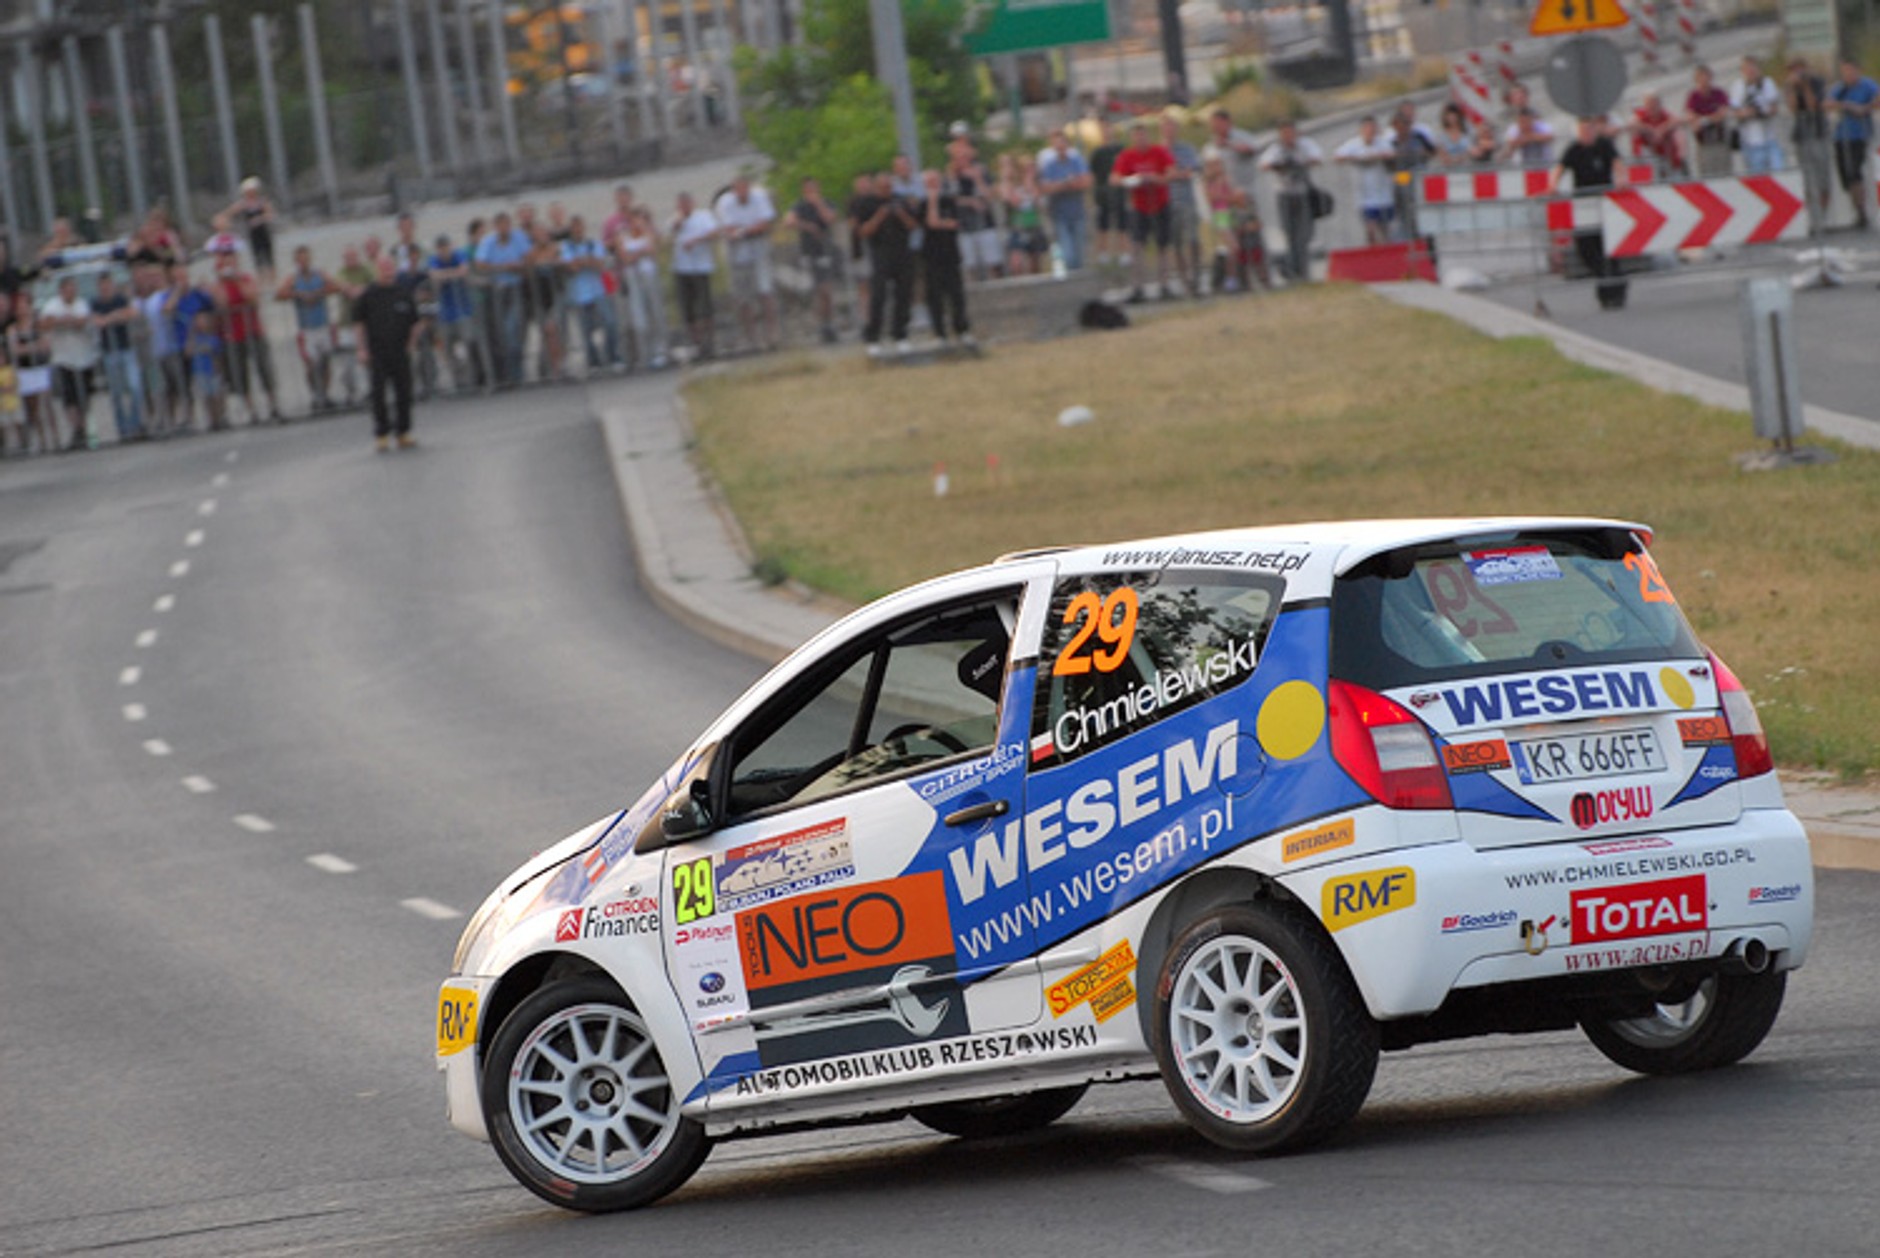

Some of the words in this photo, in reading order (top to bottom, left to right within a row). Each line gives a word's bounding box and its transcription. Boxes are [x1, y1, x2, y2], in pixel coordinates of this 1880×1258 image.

[1102, 547, 1311, 575] www.janusz.net.pl
[1053, 586, 1140, 676] 29
[1055, 631, 1258, 753] Chmielewski
[1442, 671, 1658, 727] WESEM
[1447, 742, 1496, 765] NEO
[1526, 742, 1573, 778] KR
[1579, 733, 1654, 773] 666FF
[948, 719, 1239, 906] WESEM
[673, 857, 714, 926] 29
[960, 793, 1234, 960] www.wesem.pl
[1333, 873, 1407, 916] RMF
[583, 905, 659, 938] Finance
[756, 892, 905, 976] NEO
[696, 995, 736, 1009] SUBARU
[736, 1049, 935, 1097] AUTOMOBILKLUB
